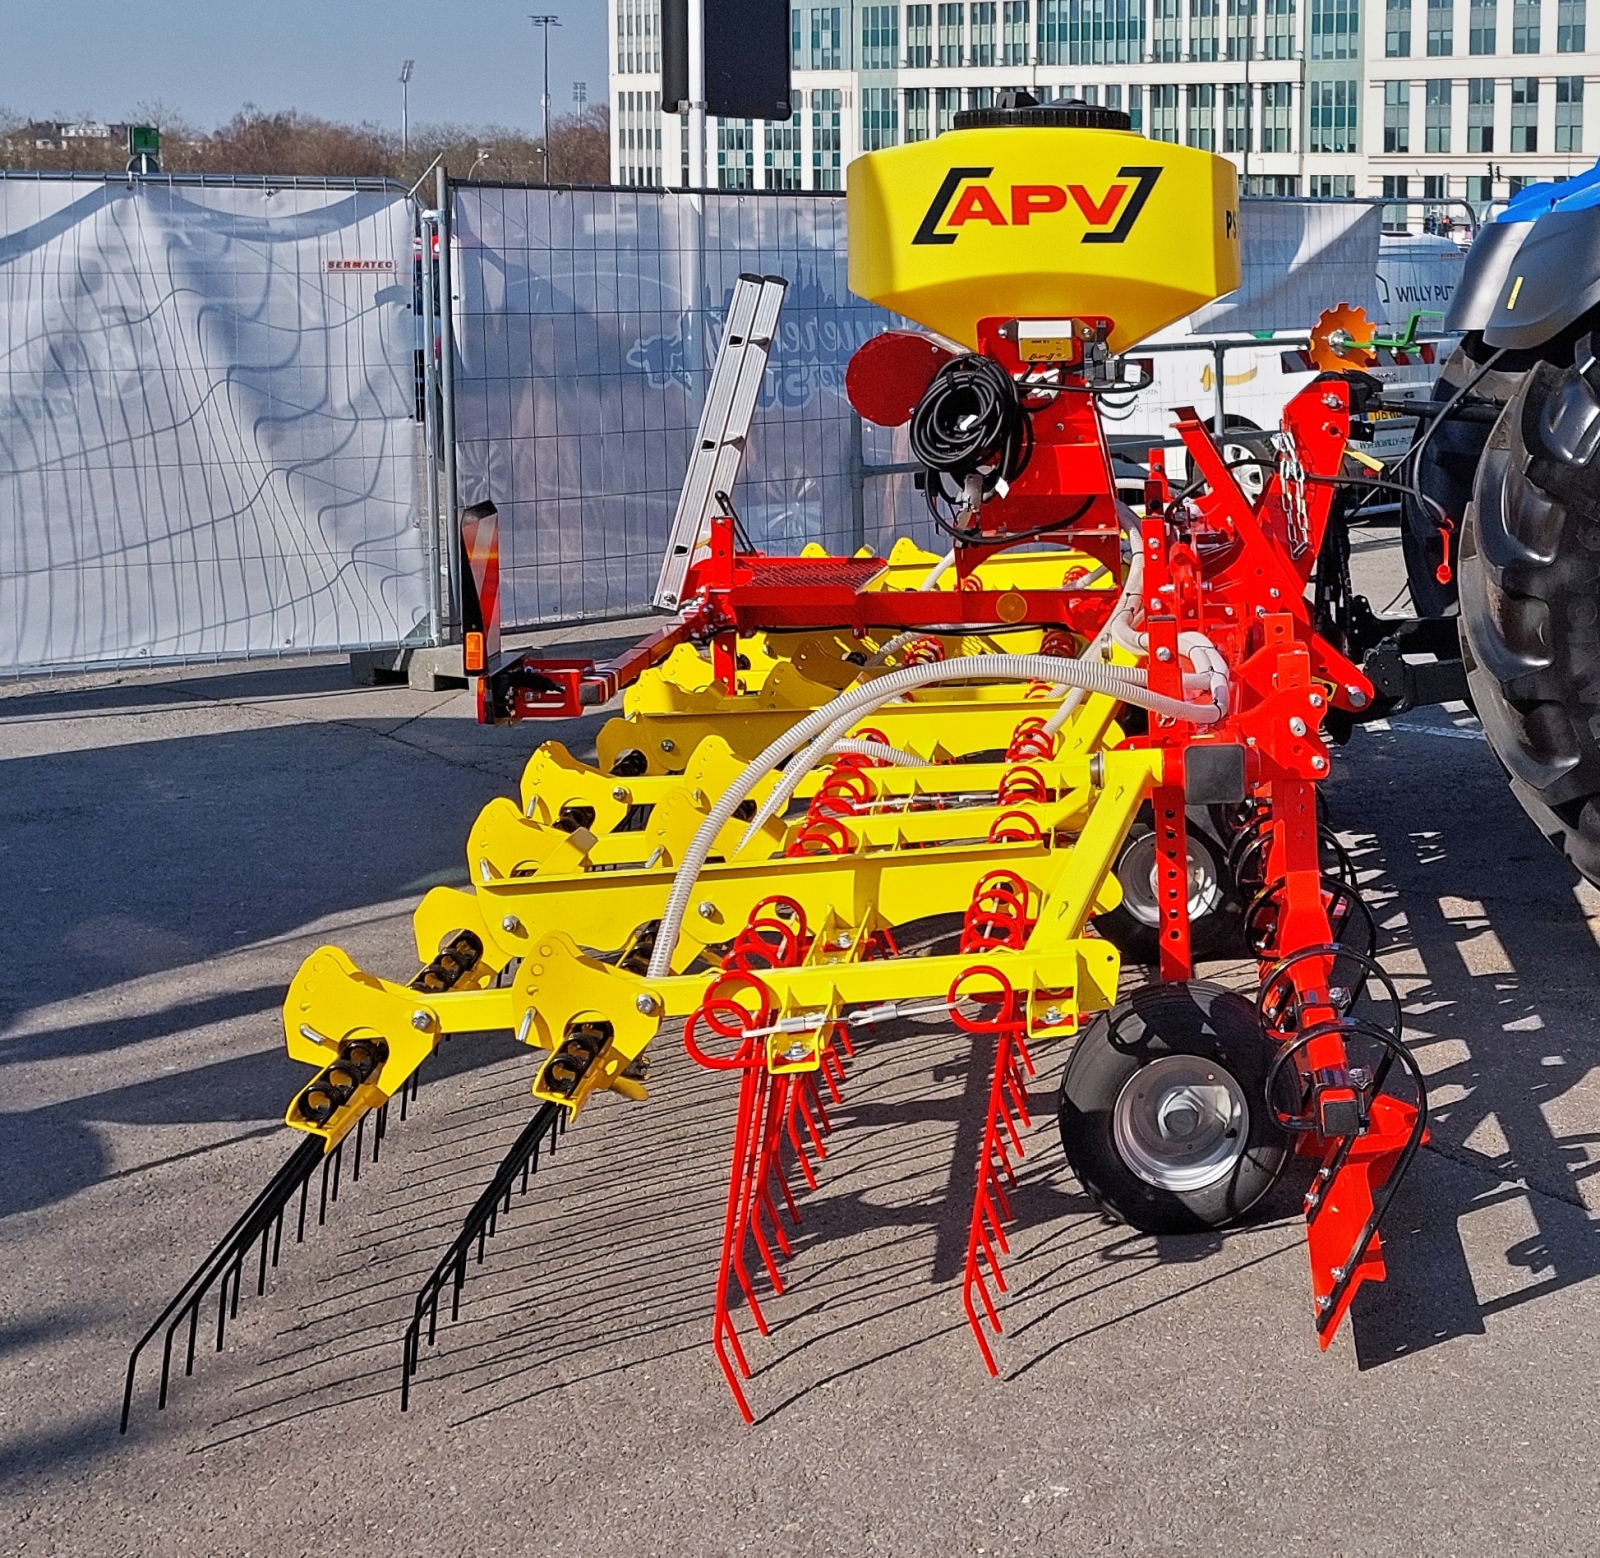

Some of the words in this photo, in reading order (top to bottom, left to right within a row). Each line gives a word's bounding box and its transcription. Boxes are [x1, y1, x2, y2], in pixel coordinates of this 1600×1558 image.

[946, 184, 1129, 226] APV
[327, 260, 393, 269] SERMATEC
[1395, 285, 1432, 303] WILLY
